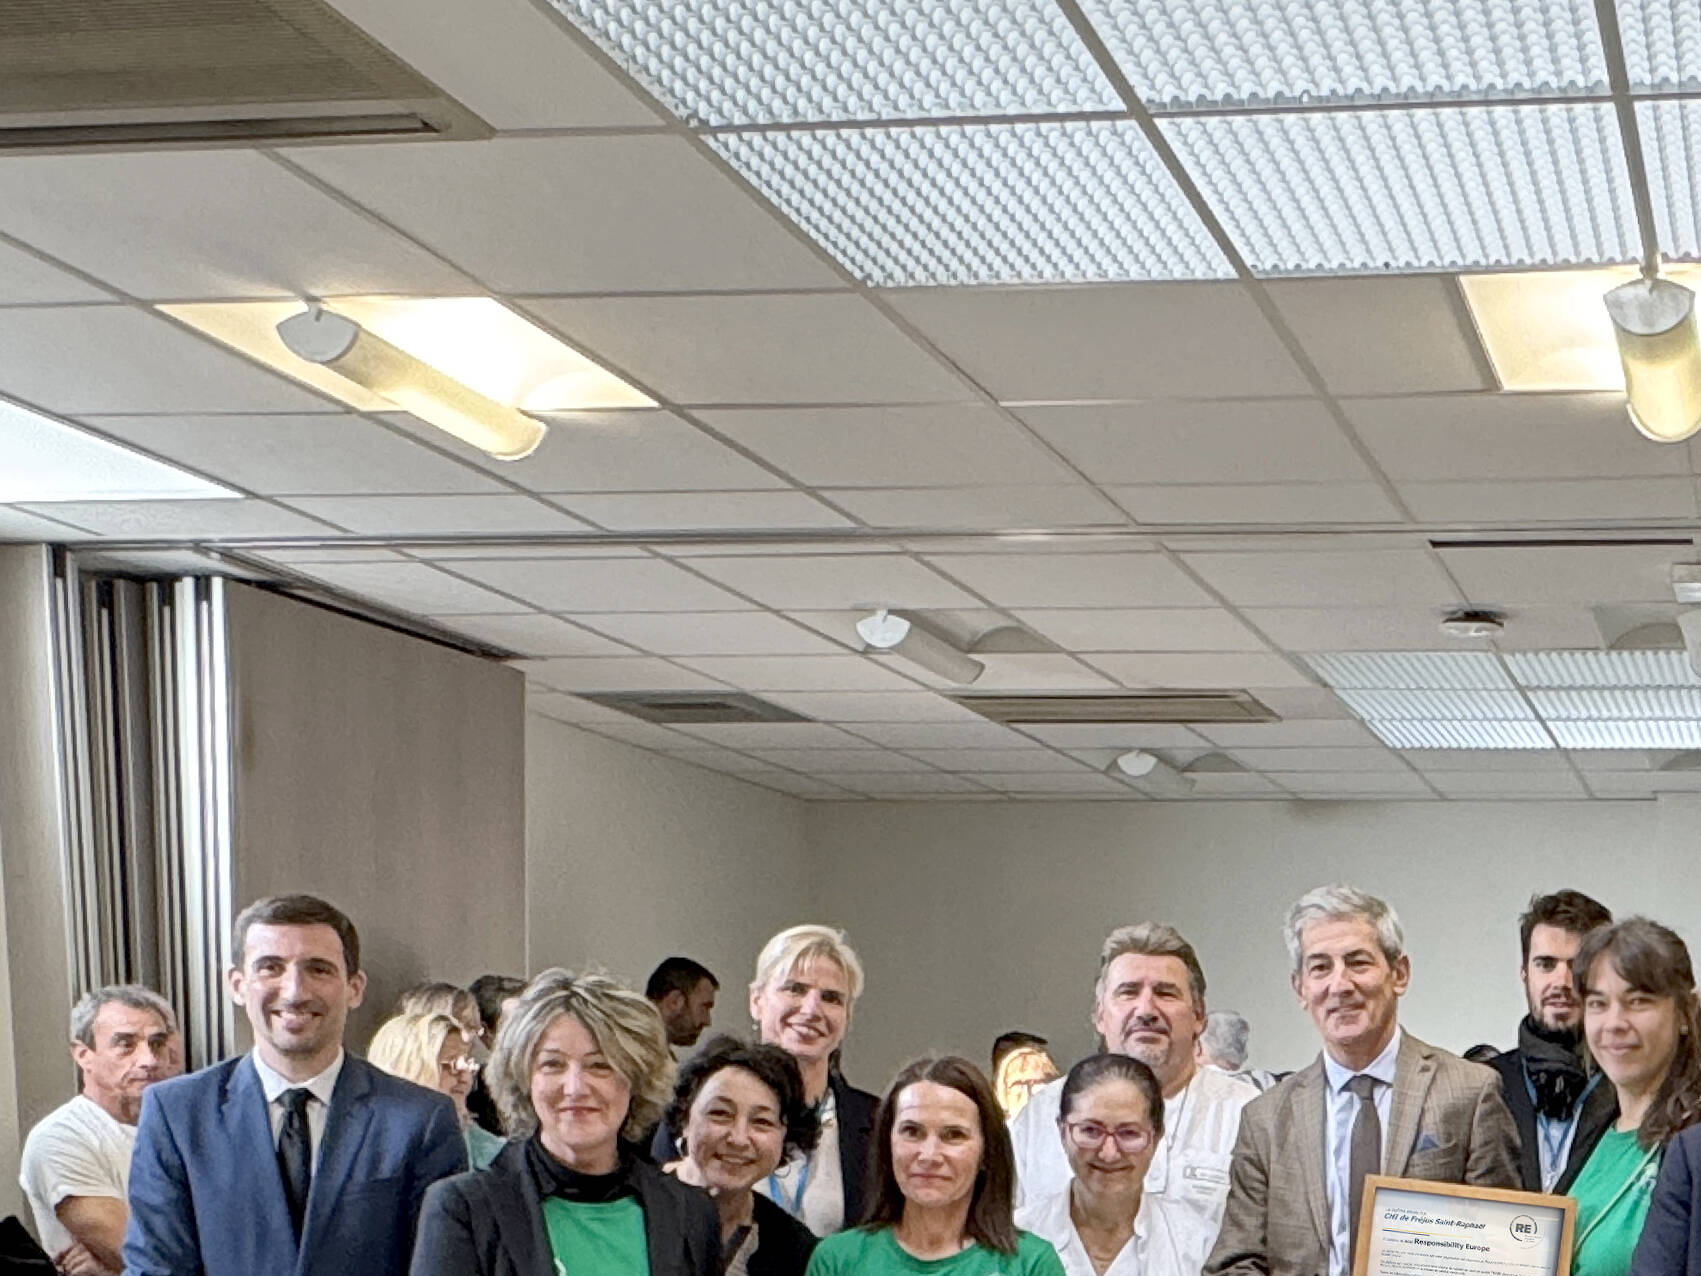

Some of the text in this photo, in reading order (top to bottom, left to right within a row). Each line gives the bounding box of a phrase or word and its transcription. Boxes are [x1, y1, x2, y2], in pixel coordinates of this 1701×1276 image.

[1515, 1223, 1532, 1234] RE
[1414, 1238, 1464, 1250] Responsibility
[1465, 1243, 1491, 1252] Europe
